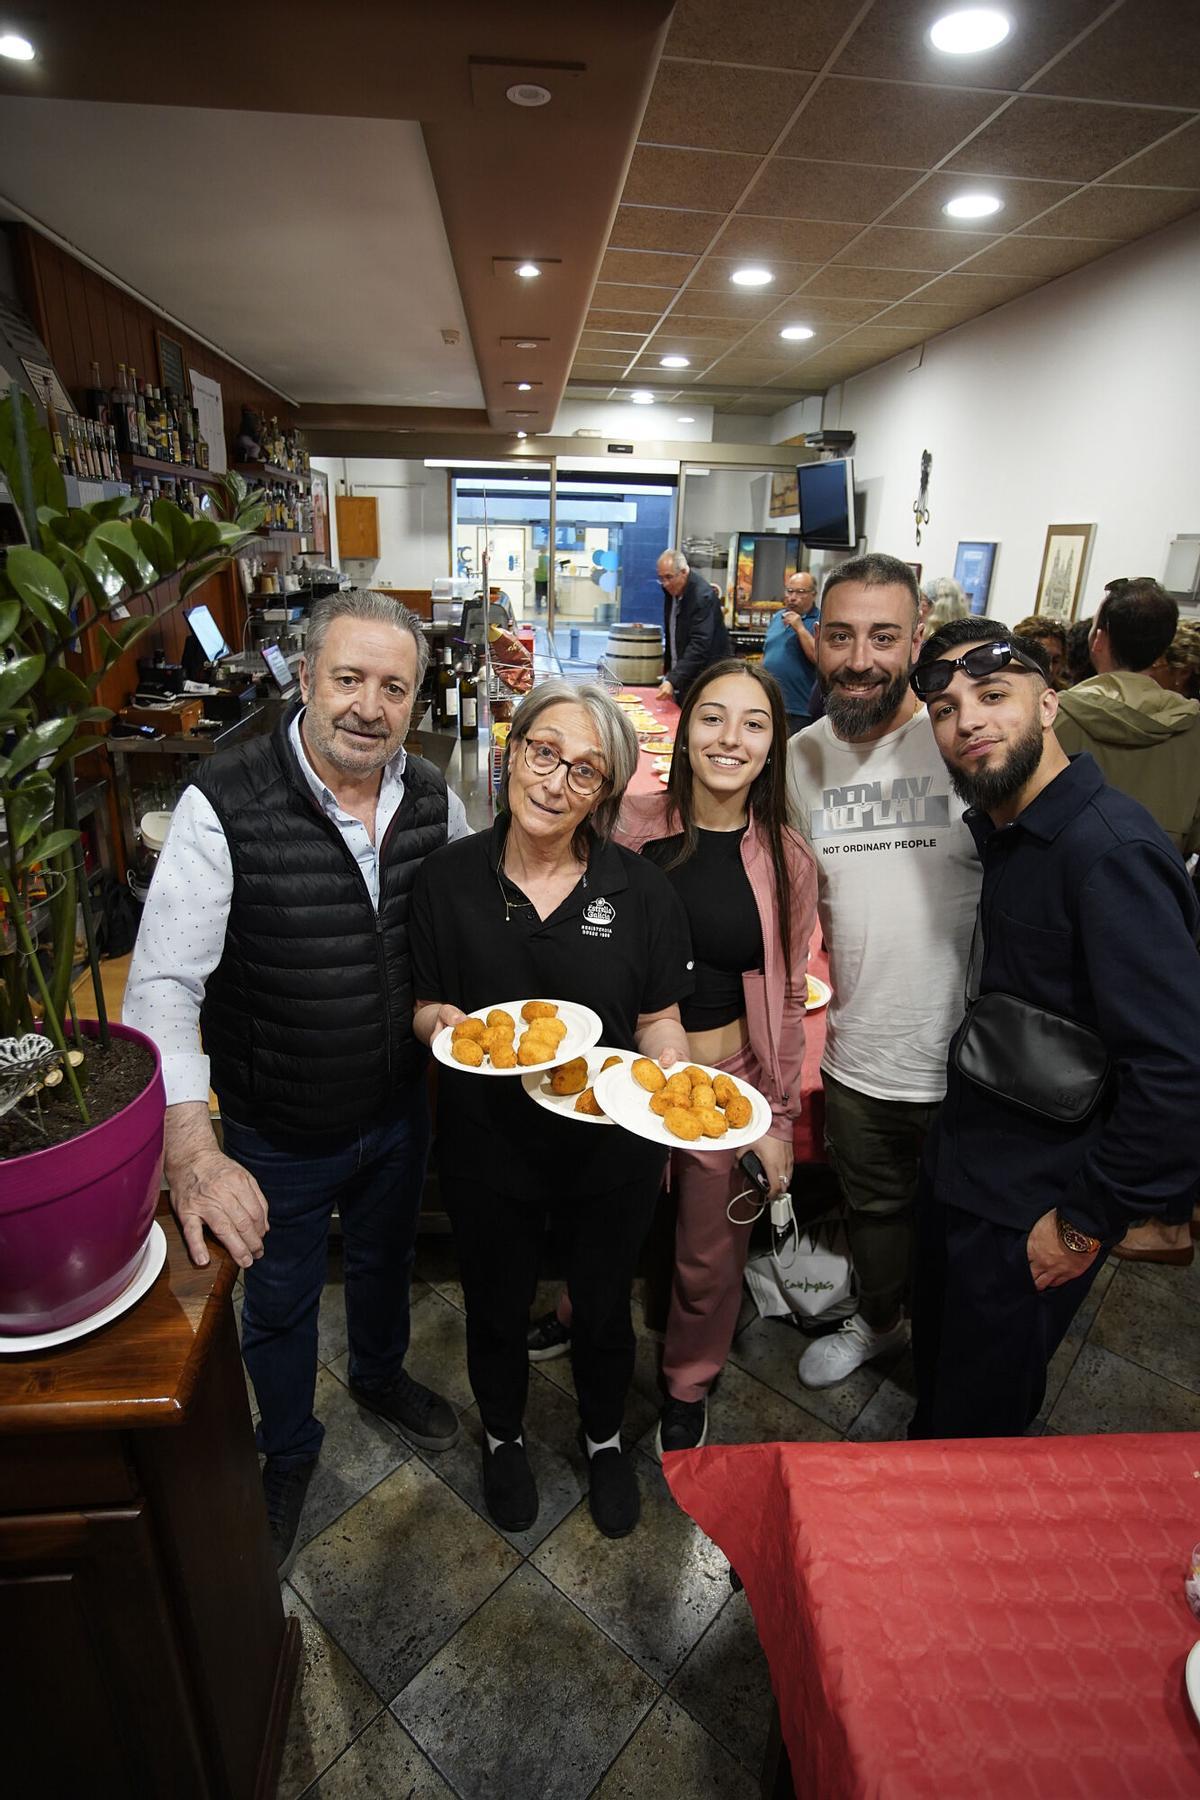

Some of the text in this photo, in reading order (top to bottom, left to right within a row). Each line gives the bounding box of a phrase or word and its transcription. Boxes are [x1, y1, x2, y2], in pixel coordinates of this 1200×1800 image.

[823, 838, 937, 855] NOT ORDINARY PEOPLE
